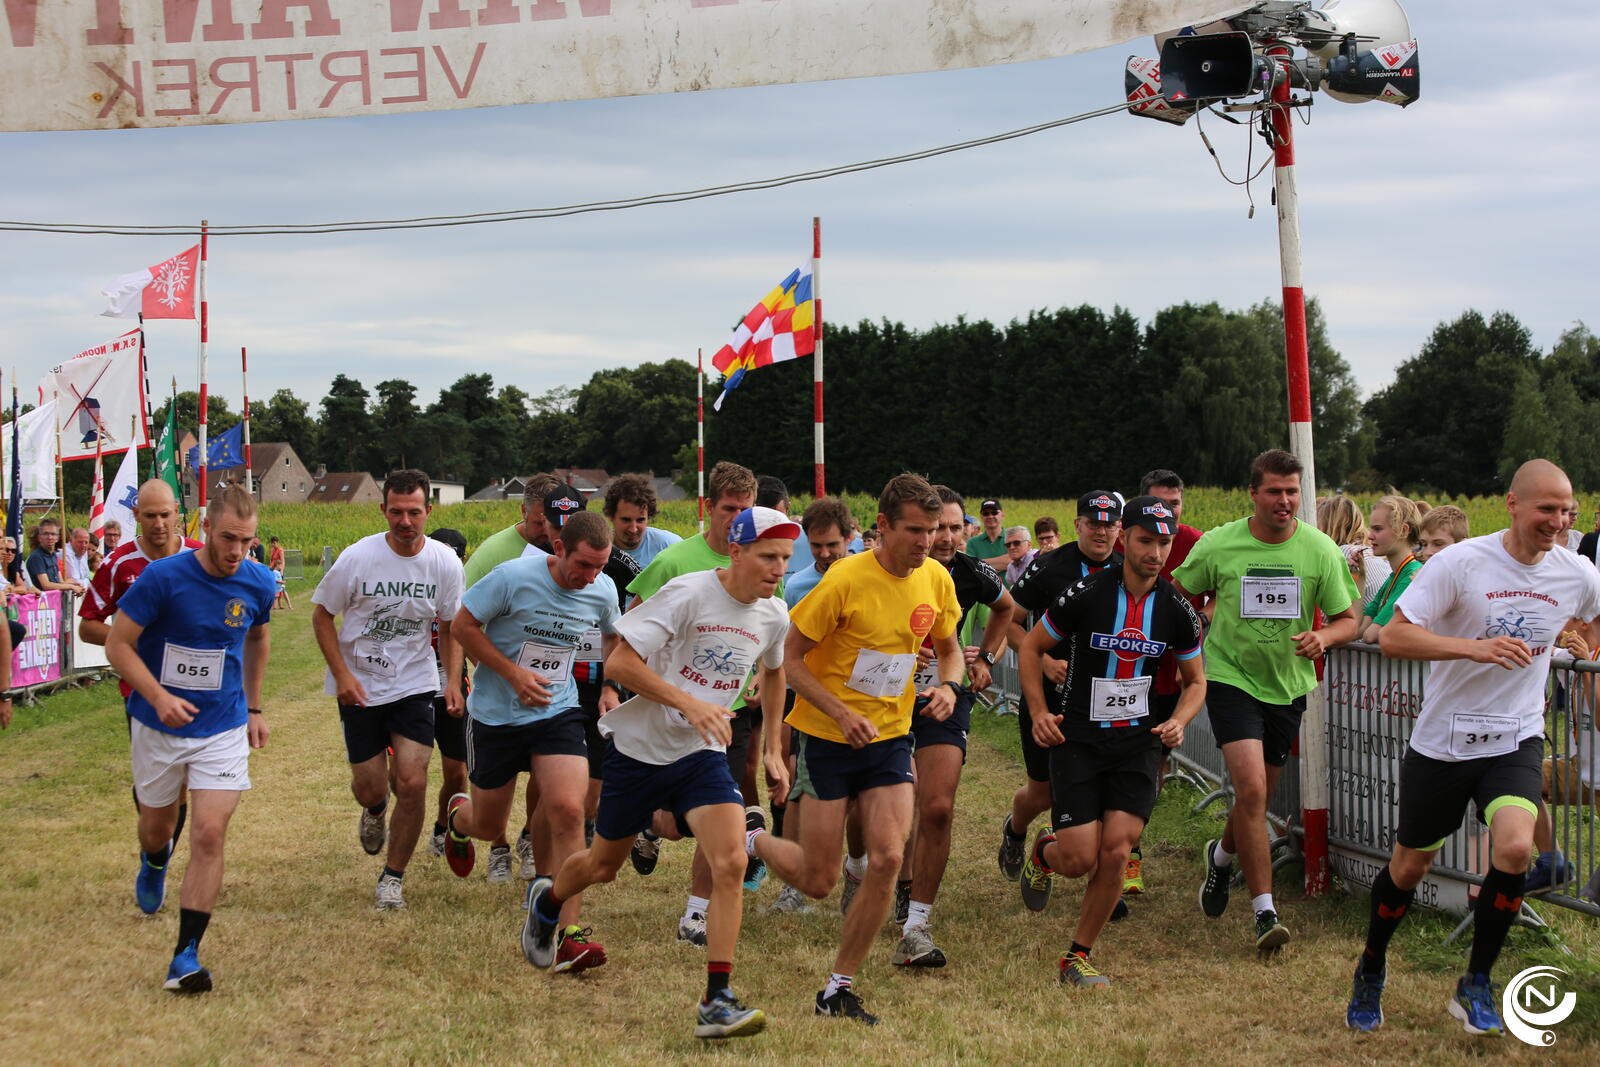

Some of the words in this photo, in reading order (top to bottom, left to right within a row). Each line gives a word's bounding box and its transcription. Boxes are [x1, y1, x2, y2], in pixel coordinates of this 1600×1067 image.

[362, 581, 437, 599] LANKEM
[1255, 592, 1287, 605] 195
[1485, 590, 1559, 608] Wielervrienden
[553, 621, 564, 630] 14
[523, 625, 580, 643] MORKHOVEN
[1123, 631, 1141, 640] WTC
[1099, 637, 1159, 655] EPOKES
[177, 663, 209, 677] 055
[529, 658, 560, 670] 260
[679, 664, 708, 687] Effe
[913, 674, 934, 685] 27
[1105, 694, 1137, 707] 258
